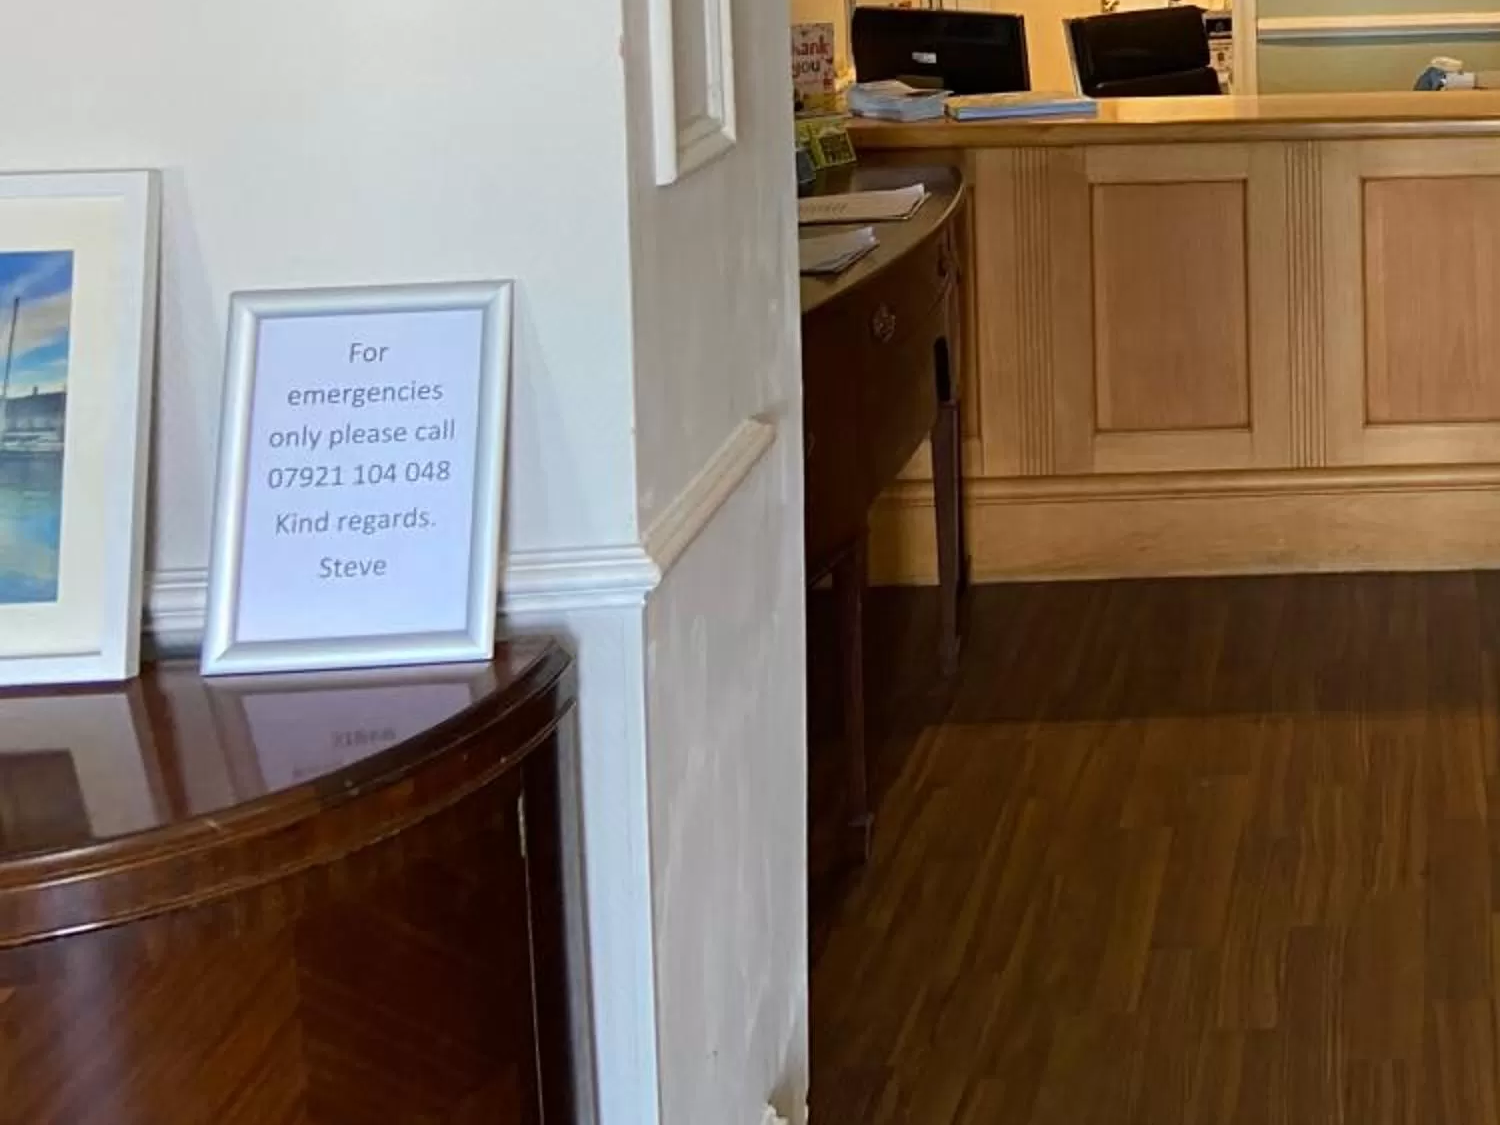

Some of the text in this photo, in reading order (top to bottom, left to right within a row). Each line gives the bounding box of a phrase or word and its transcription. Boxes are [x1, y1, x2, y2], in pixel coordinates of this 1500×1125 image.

[792, 34, 831, 56] hank
[349, 341, 390, 364] For
[287, 380, 444, 408] emergencies
[268, 419, 456, 451] only please call
[267, 460, 451, 490] 07921 104 048
[275, 506, 437, 536] Kind regards.
[319, 556, 388, 579] Steve
